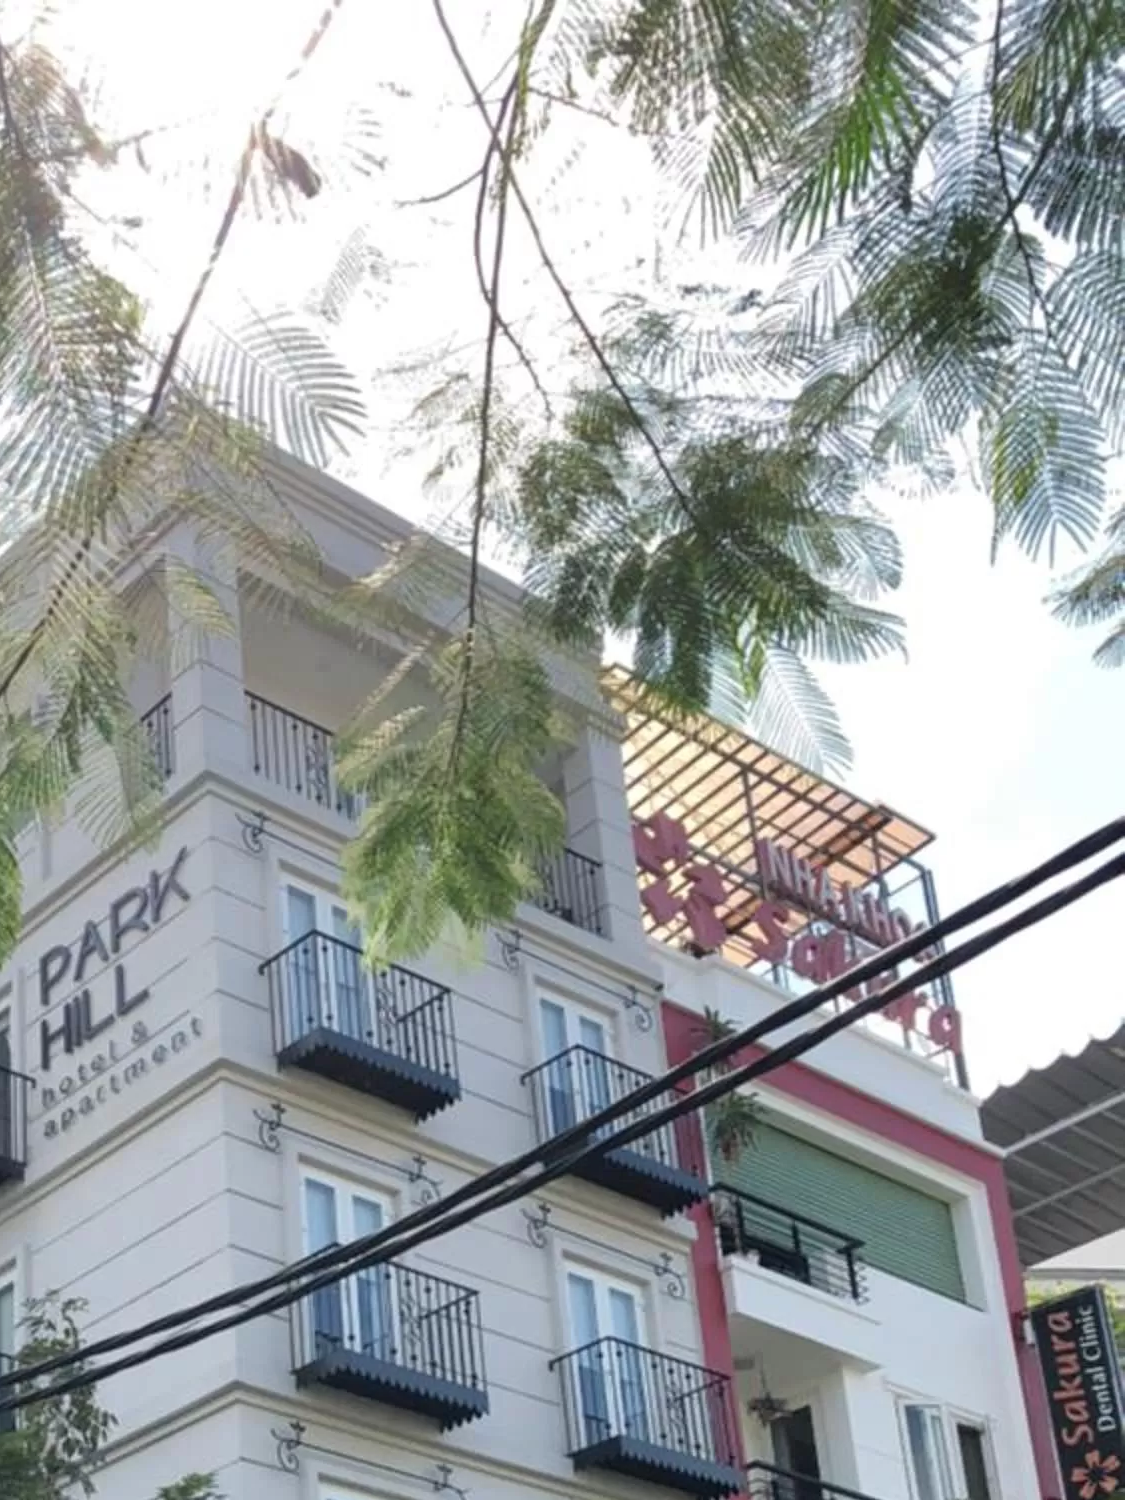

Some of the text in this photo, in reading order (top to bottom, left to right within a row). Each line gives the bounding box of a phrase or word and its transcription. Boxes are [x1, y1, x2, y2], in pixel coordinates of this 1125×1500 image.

[39, 845, 191, 1005] PARK
[41, 963, 150, 1071] HILL
[42, 1039, 121, 1107] hotel
[43, 1016, 203, 1139] apartment
[1049, 1311, 1094, 1445] Sakura
[1076, 1304, 1116, 1432] Dental Clinic
